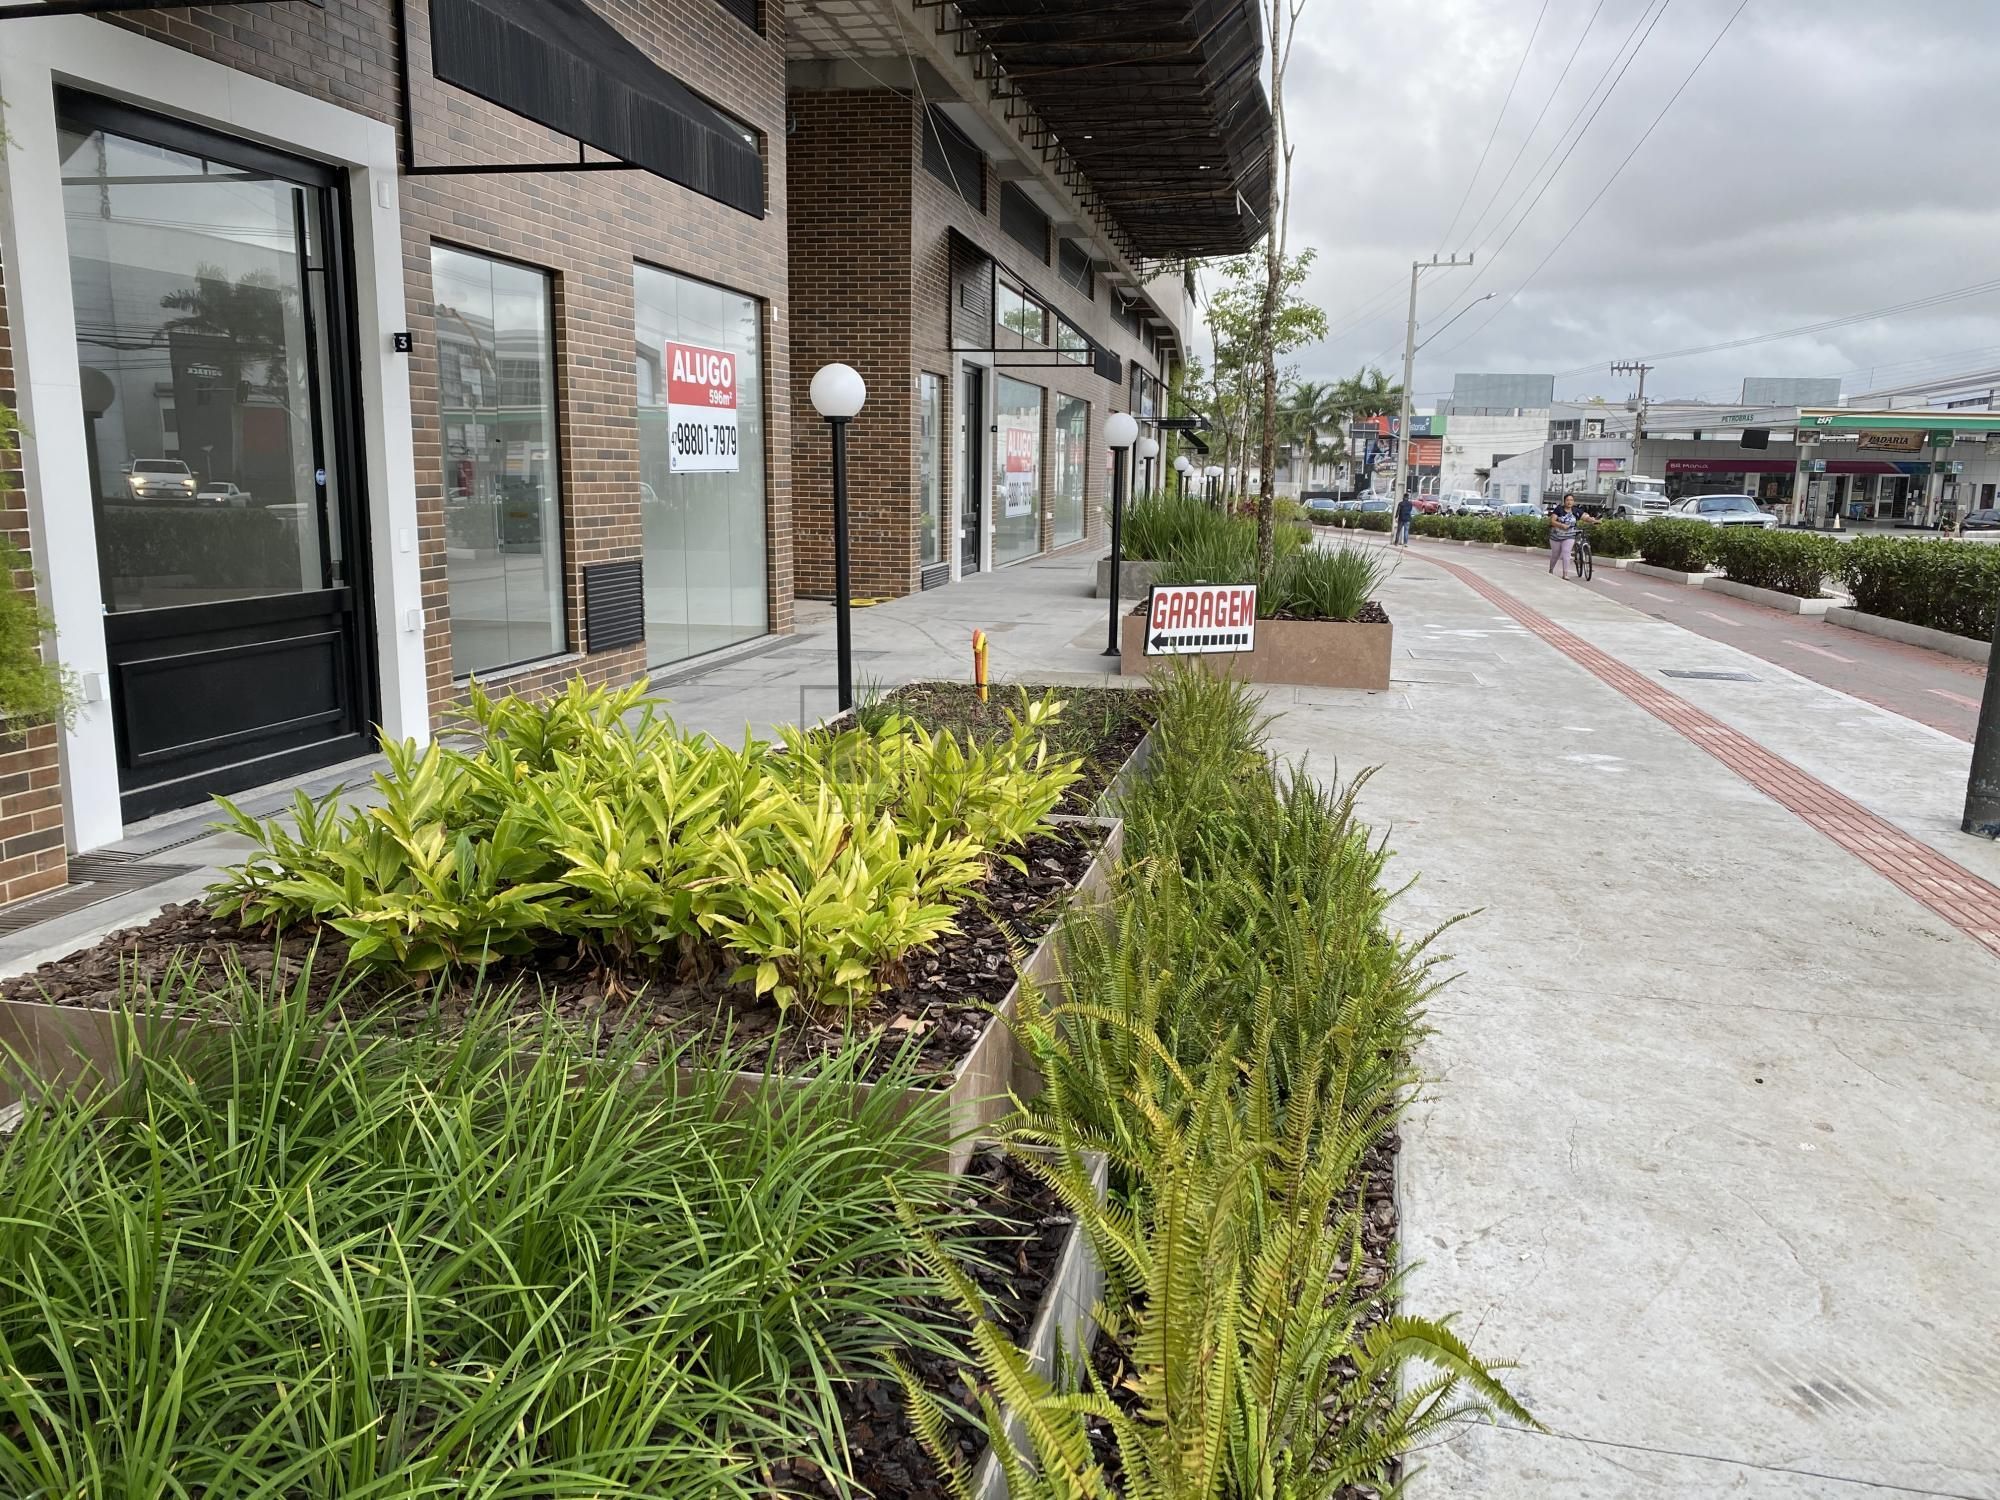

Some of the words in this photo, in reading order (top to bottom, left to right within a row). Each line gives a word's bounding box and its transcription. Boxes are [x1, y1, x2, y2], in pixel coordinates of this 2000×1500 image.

[398, 336, 408, 349] 3
[672, 349, 732, 388] ALUGO
[1721, 414, 1754, 422] PETROBRAS
[1816, 415, 1833, 424] BR
[677, 422, 737, 456] 98801-7979
[1008, 430, 1032, 457] ALUGO
[1867, 436, 1909, 445] PADARIA
[1152, 590, 1255, 630] GARAGEM
